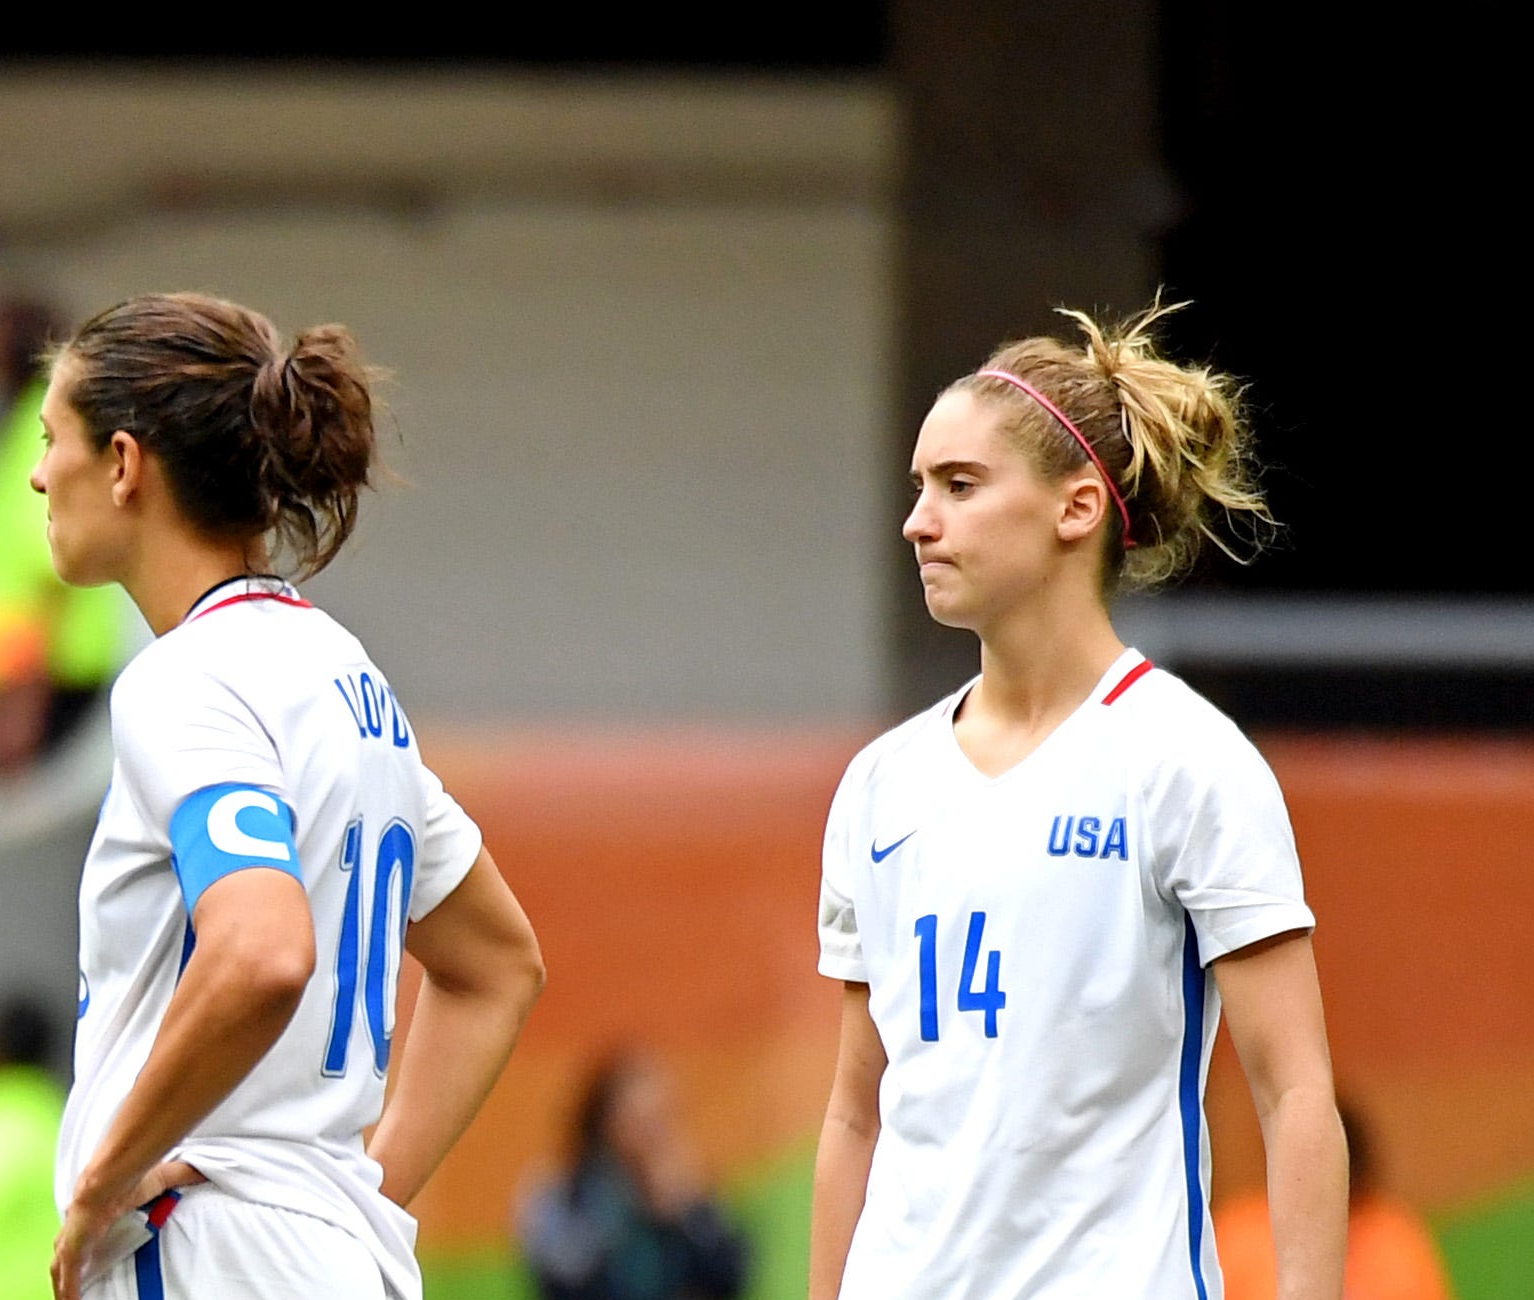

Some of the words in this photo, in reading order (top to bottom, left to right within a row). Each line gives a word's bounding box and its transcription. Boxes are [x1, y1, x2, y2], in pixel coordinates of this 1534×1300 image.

[207, 790, 291, 861] C
[1046, 814, 1129, 861] USA
[321, 814, 416, 1079] 10
[914, 911, 1006, 1042] 14
